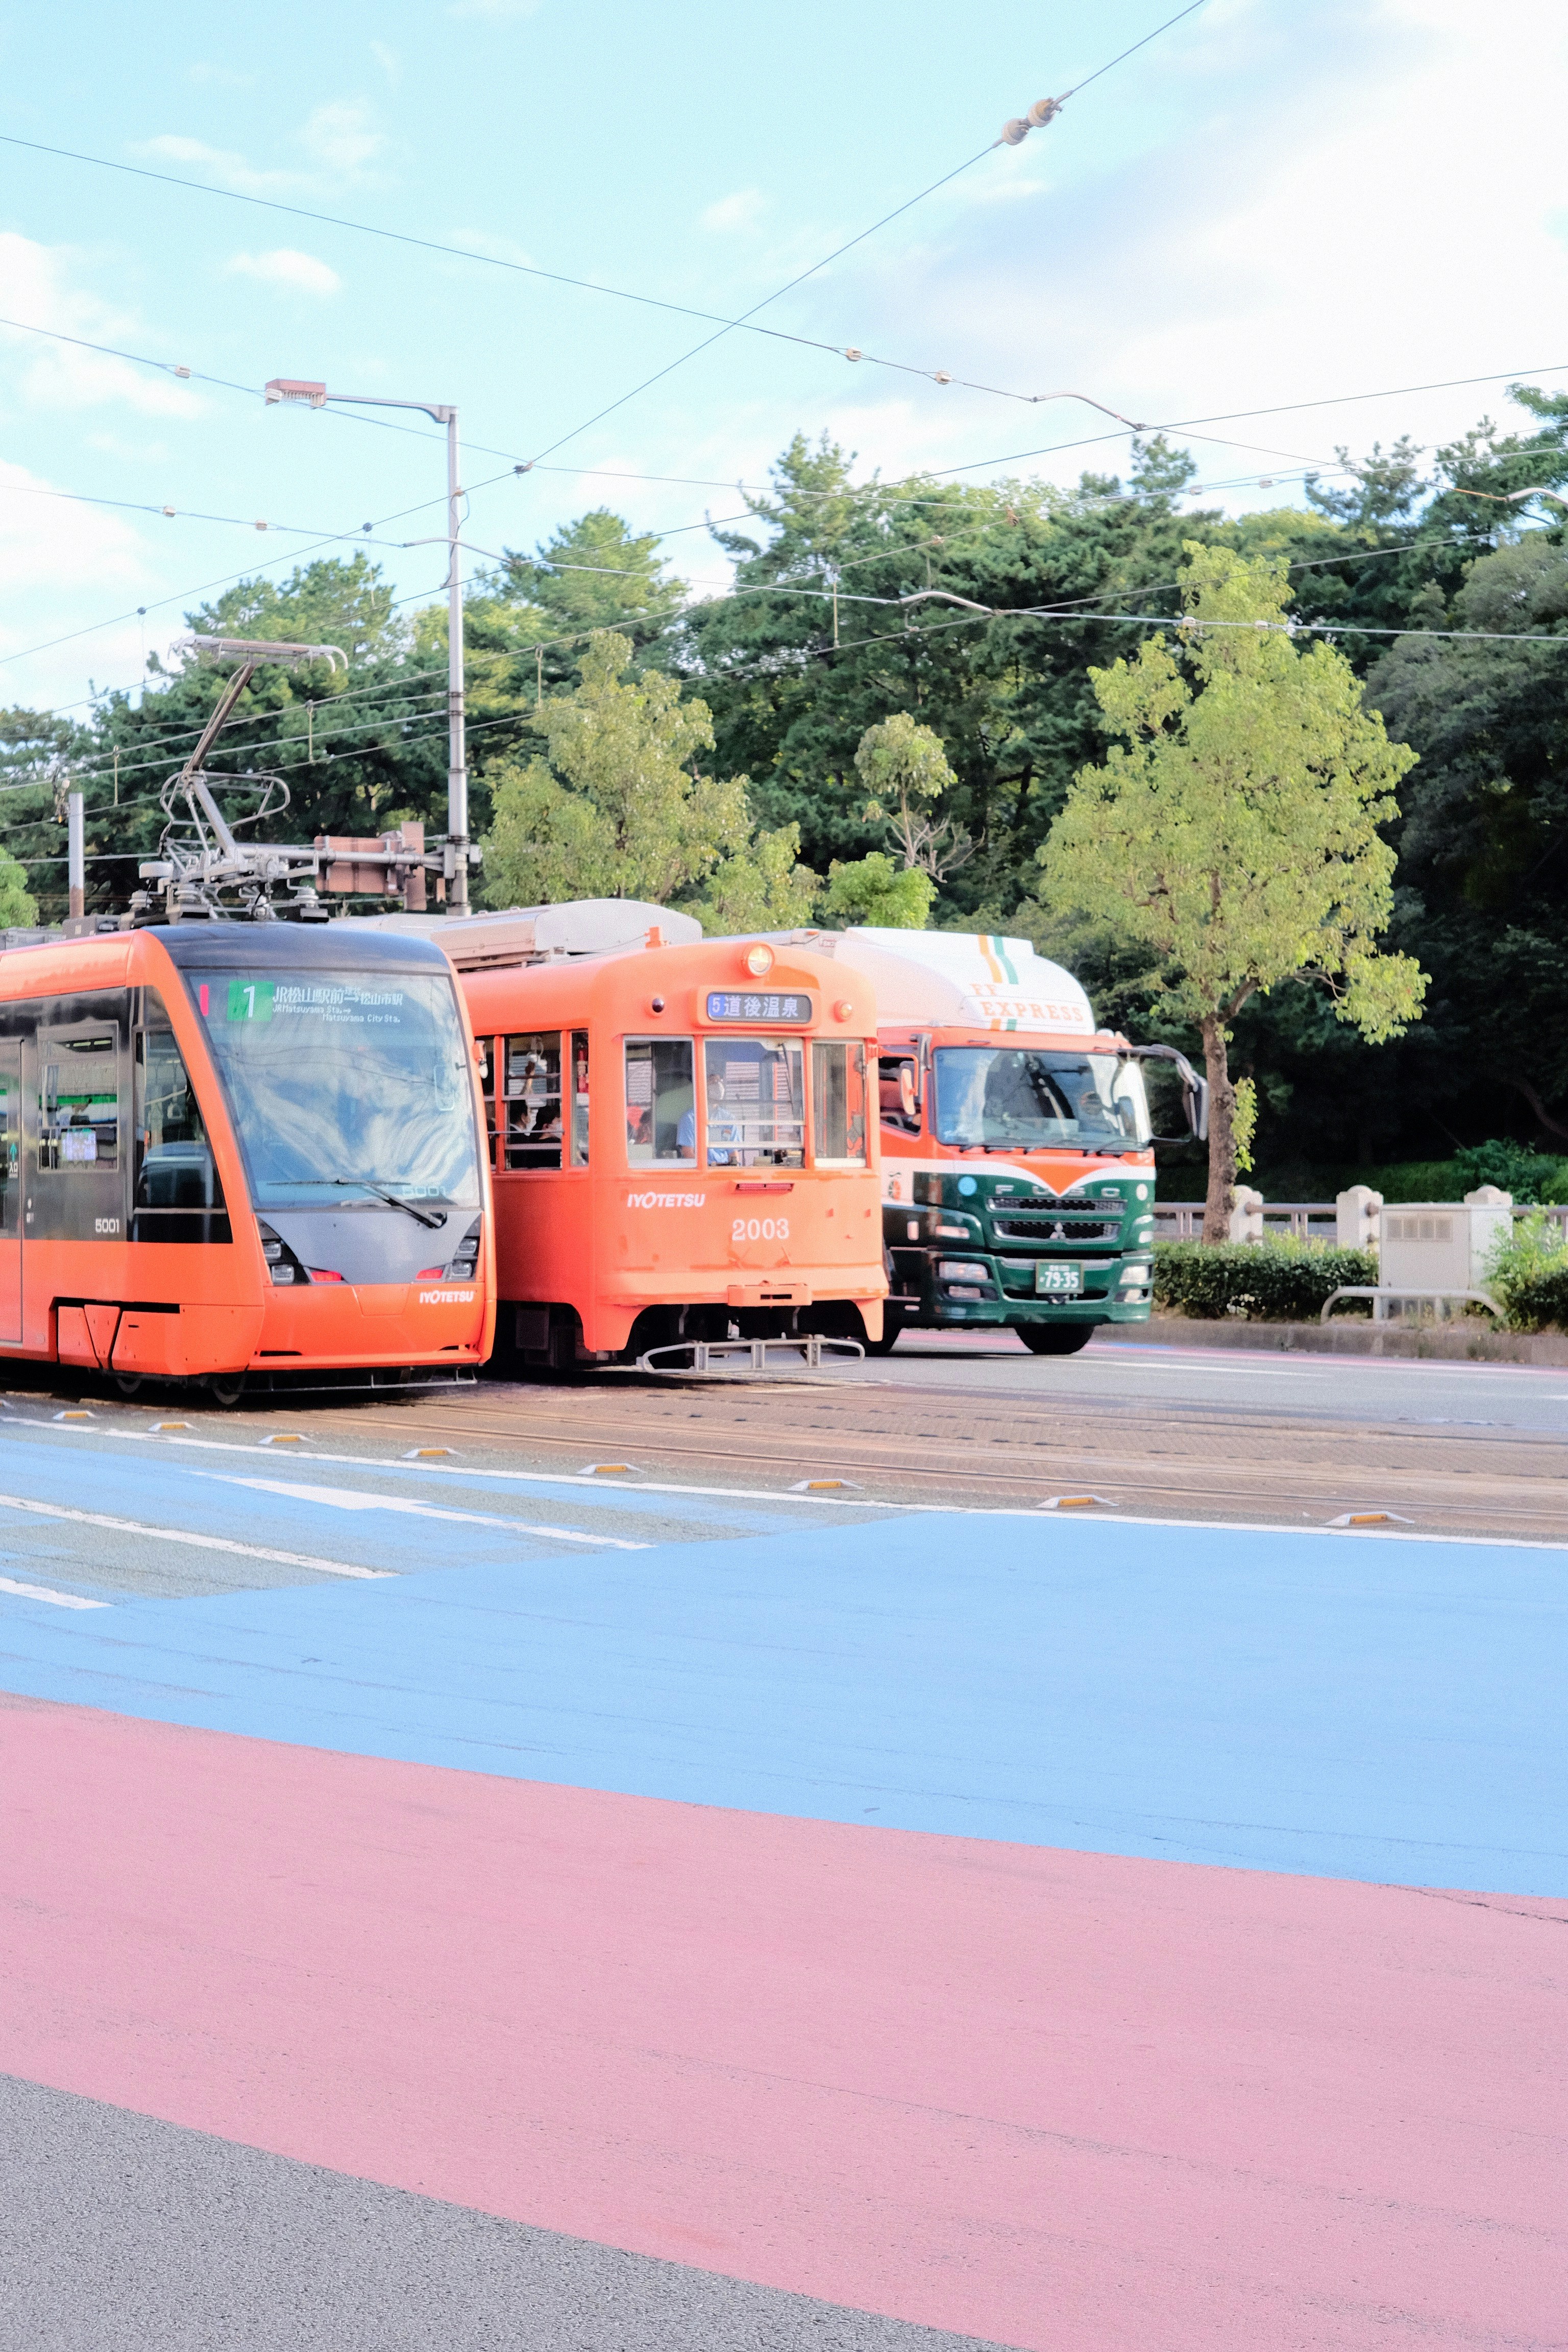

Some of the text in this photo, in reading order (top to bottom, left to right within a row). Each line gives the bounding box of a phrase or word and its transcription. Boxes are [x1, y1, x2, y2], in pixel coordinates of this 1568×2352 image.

[243, 986, 256, 1018] 1
[360, 992, 403, 1006] 松山市駅
[712, 997, 721, 1013] 5
[724, 996, 798, 1018] 道後温泉
[323, 1014, 401, 1023] Matsuyama City Sta.
[980, 1001, 1083, 1022] EXPRESS
[995, 1185, 1120, 1197] FUSO
[627, 1191, 706, 1209] IYOTETSU
[95, 1218, 119, 1233] 5001
[731, 1218, 790, 1240] 2003
[419, 1289, 474, 1304] IYOTETSU
